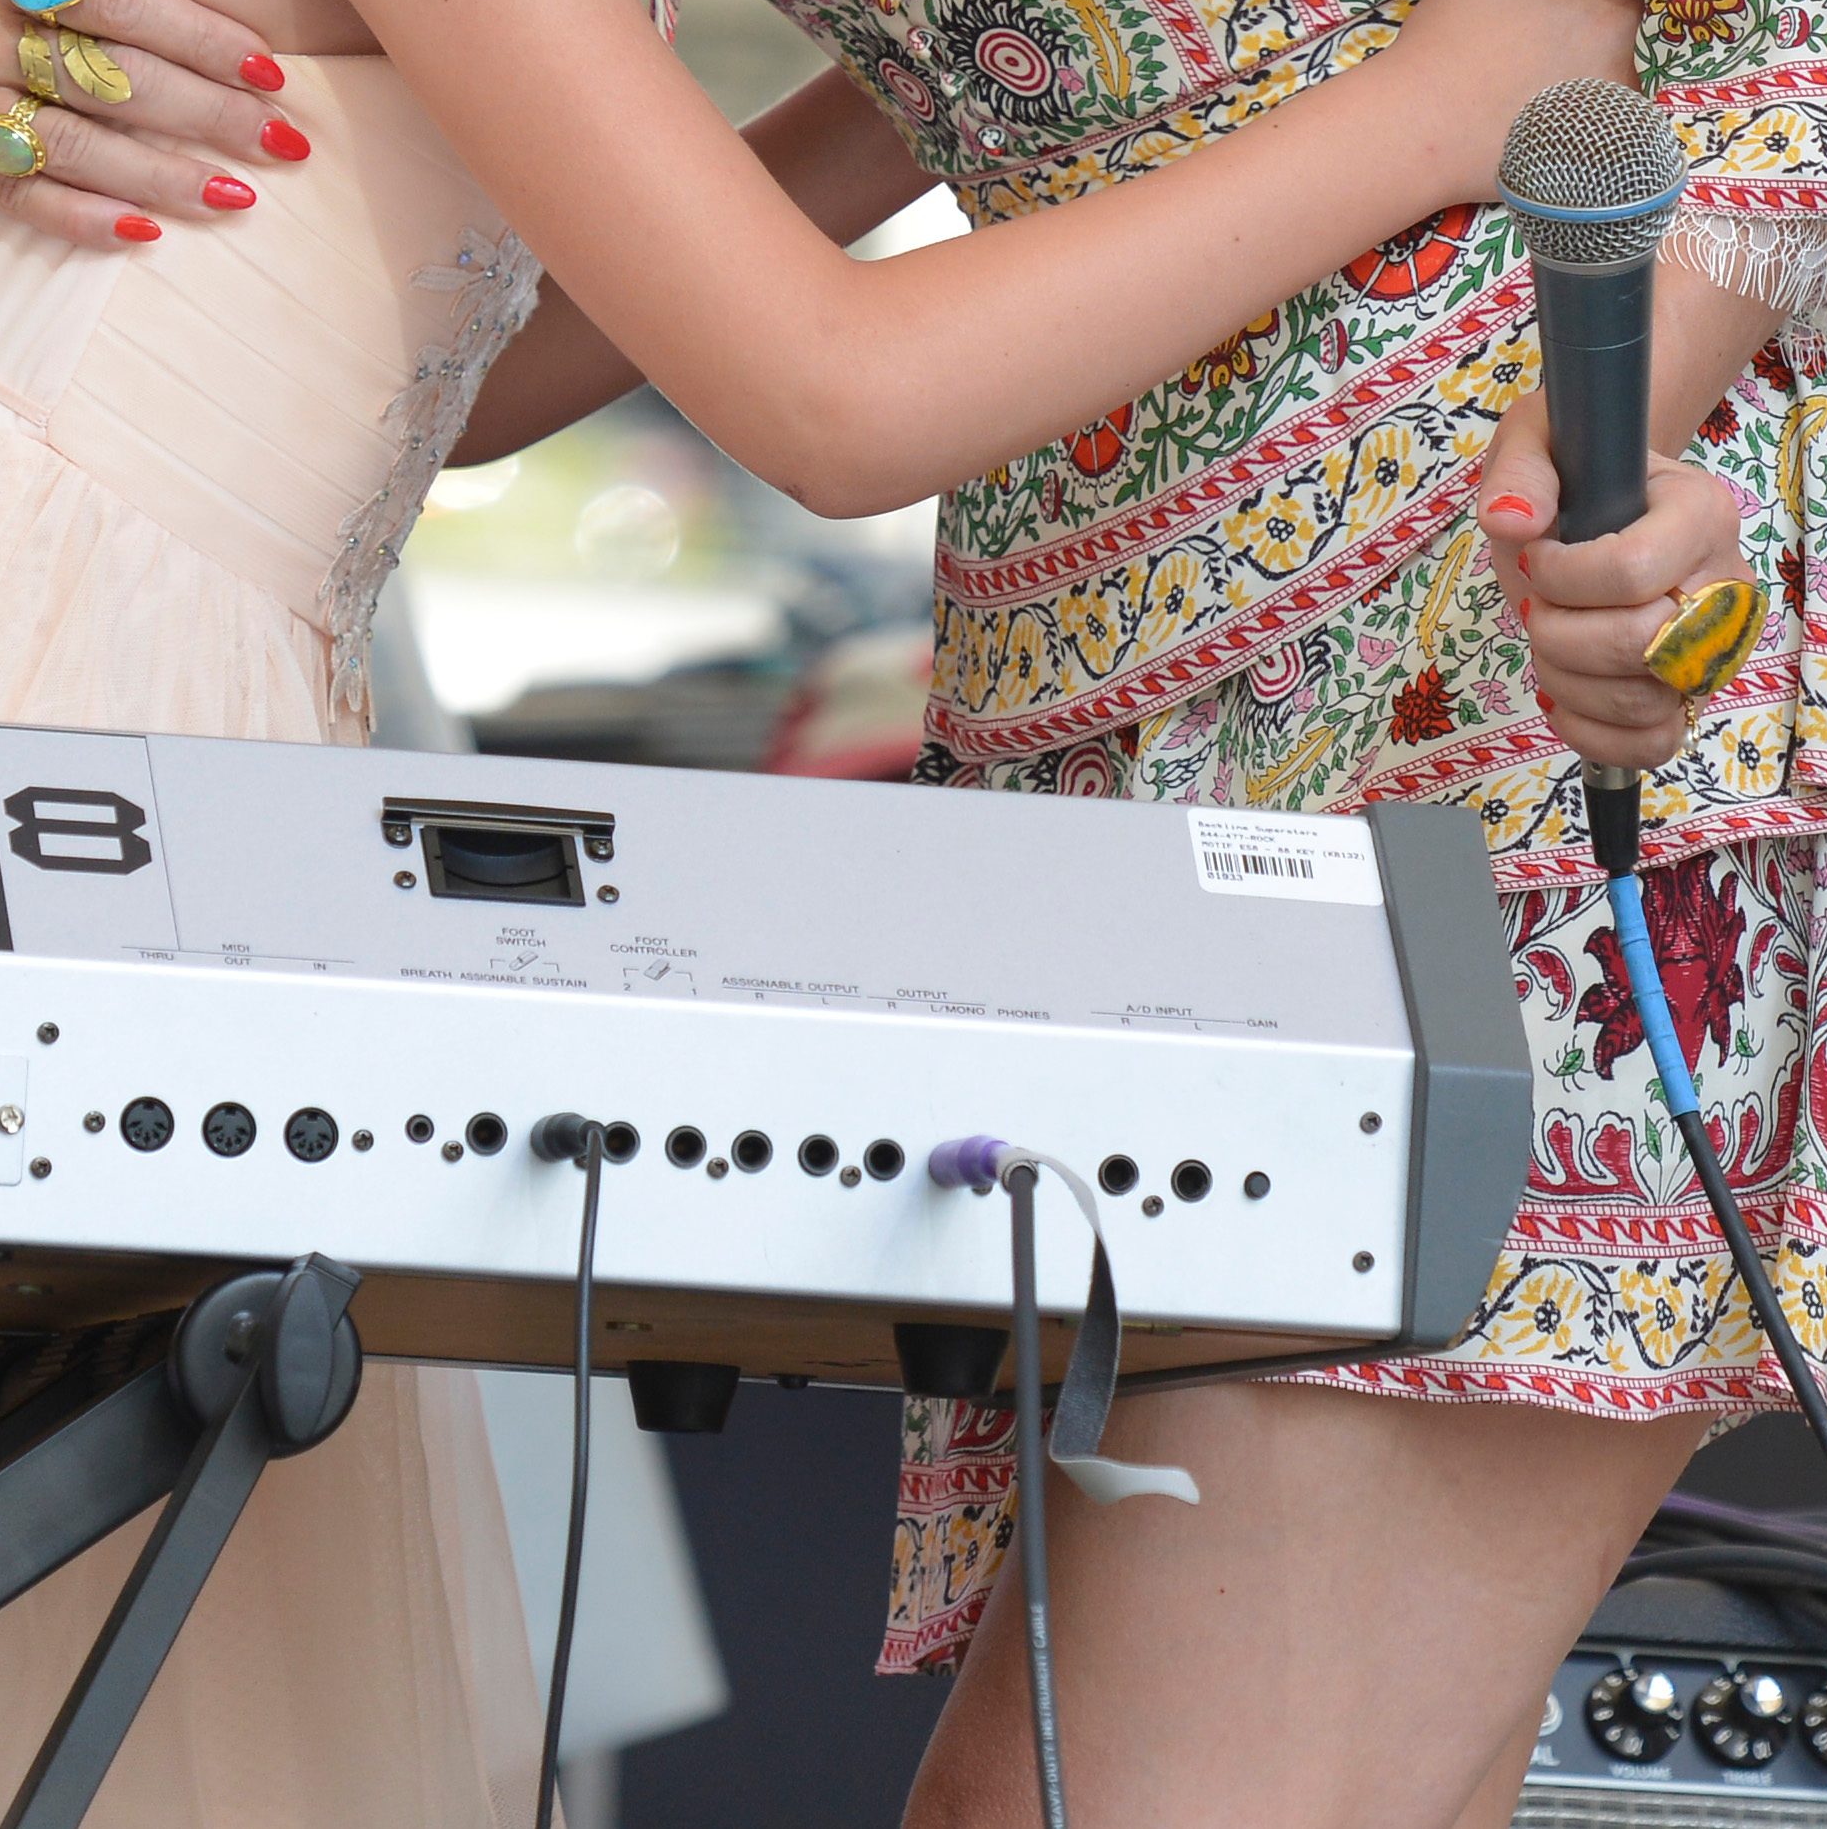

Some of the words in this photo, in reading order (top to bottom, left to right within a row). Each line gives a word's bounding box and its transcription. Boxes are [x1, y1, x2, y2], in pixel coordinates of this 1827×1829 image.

[1201, 841, 1232, 849] MOTIF
[1296, 848, 1315, 856] KEY
[501, 927, 536, 938] FOOT
[495, 936, 546, 947] SWITCH
[635, 936, 669, 946] FOOT
[222, 943, 249, 953] MIDI
[610, 944, 697, 958] CONTROLLER
[139, 950, 174, 961] THRU
[224, 956, 250, 966] OUT
[313, 962, 327, 971] IN
[400, 968, 453, 980] BREATH
[460, 972, 527, 985] ASSIGNABLE
[532, 976, 587, 988] SUSTAIN
[624, 983, 631, 991] 2
[722, 977, 802, 991] ASSIGNABLE
[808, 982, 860, 995] OUTPUT
[755, 993, 764, 1001] R
[896, 989, 948, 1000] OUTPUT
[887, 1002, 897, 1010] R
[930, 1004, 986, 1016] L/MONO
[1126, 1004, 1151, 1014] A/D
[1155, 1007, 1193, 1017] INPUT
[997, 1008, 1051, 1020] PHONES
[1121, 1018, 1131, 1026] R
[1194, 1022, 1202, 1031] L
[1246, 1019, 1278, 1029] GAIN
[1031, 1603, 1046, 1648] CABLE
[1036, 1655, 1054, 1740] INSTRUMENT
